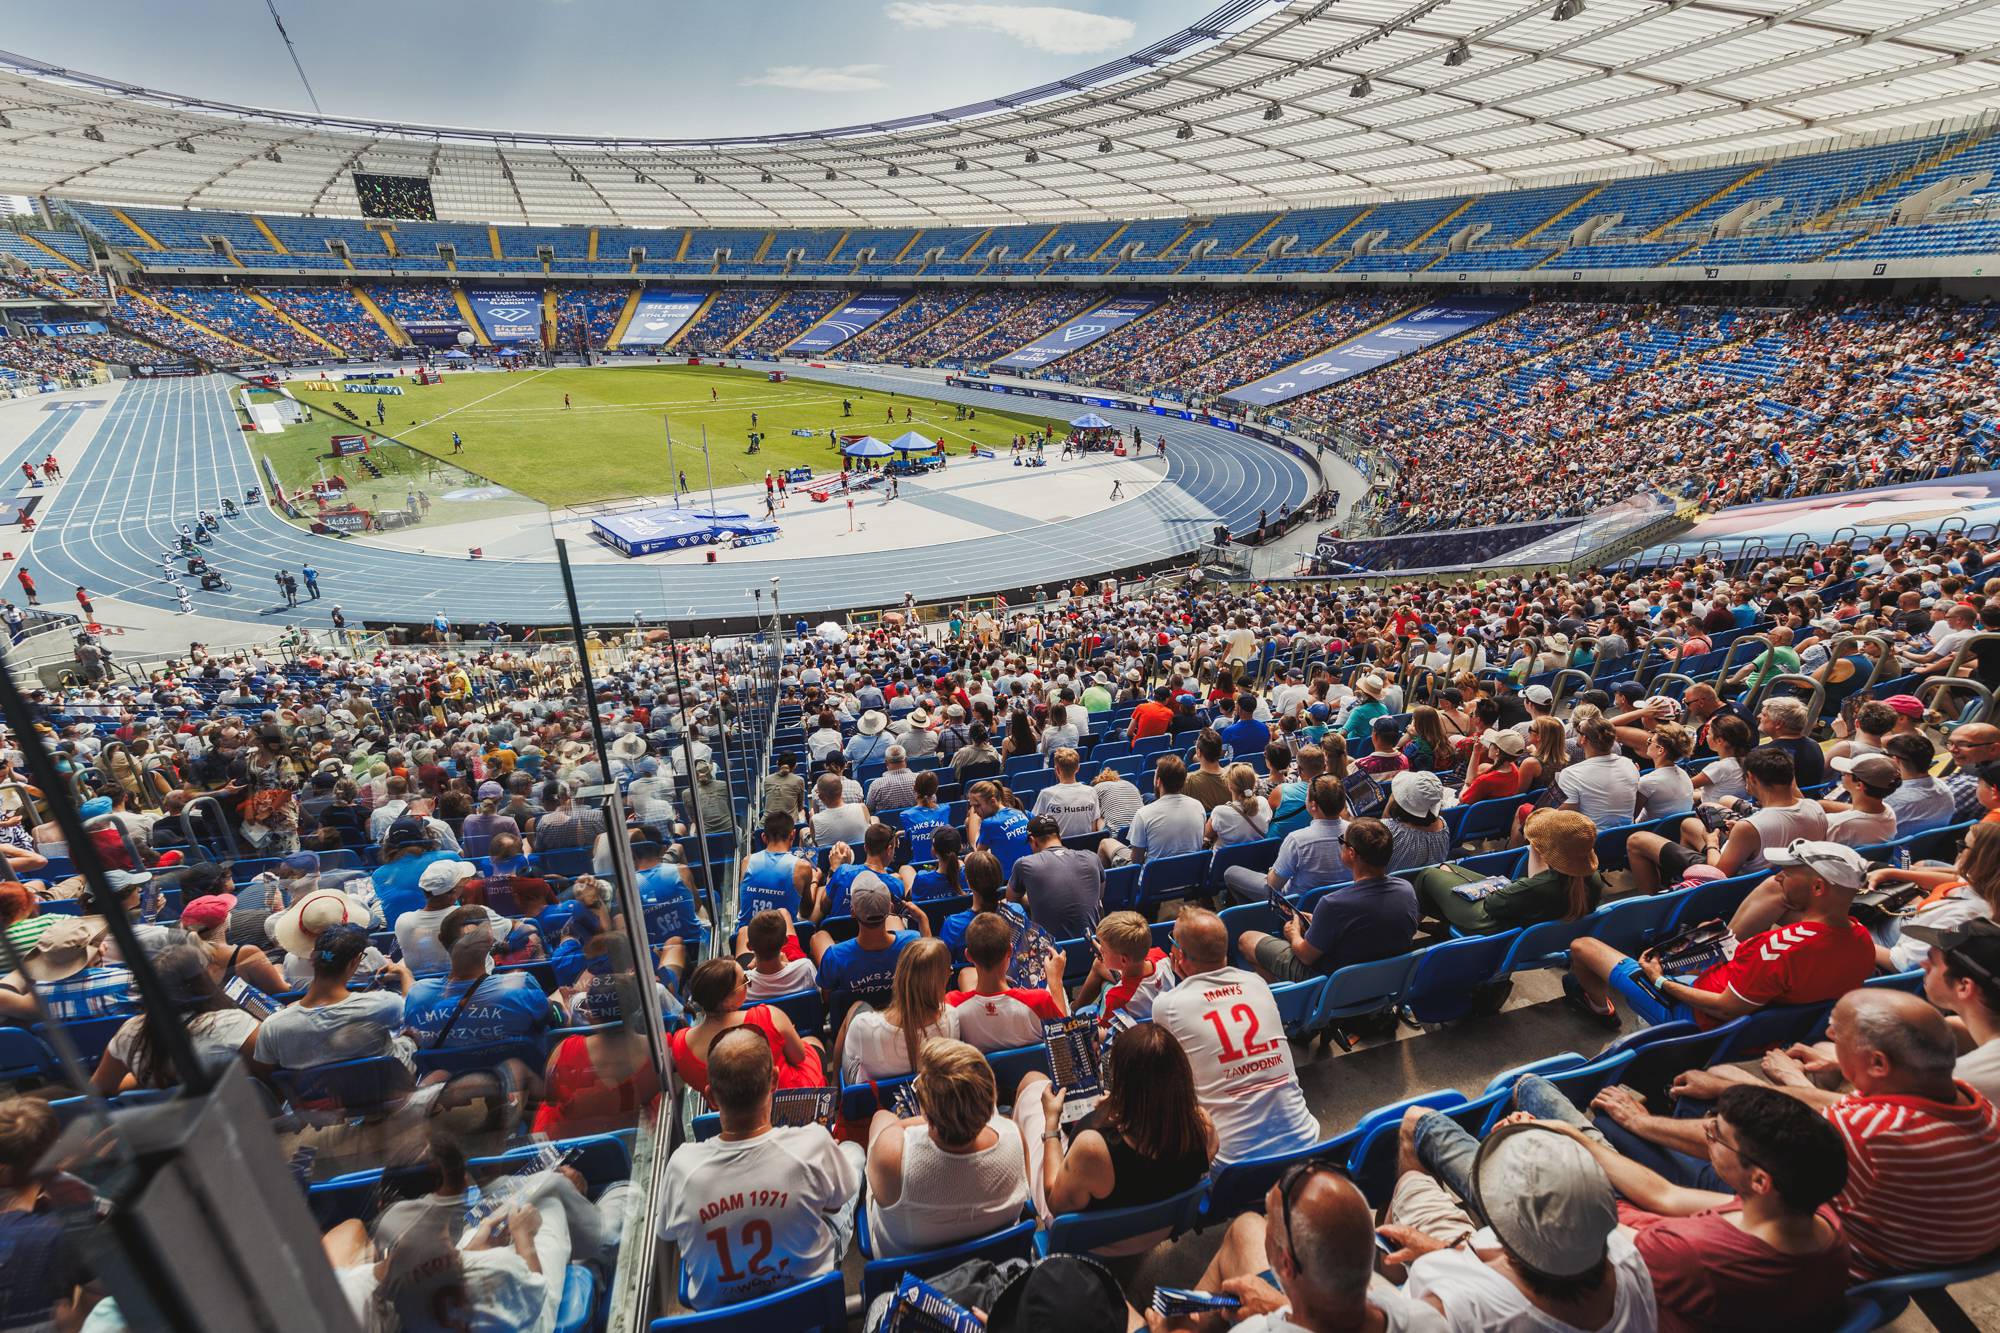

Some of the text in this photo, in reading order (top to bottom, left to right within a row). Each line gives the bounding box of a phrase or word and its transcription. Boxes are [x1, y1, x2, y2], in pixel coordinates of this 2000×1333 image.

[57, 325, 90, 334] SILESIA
[745, 536, 772, 545] SILESIA
[1050, 806, 1061, 814] KS
[912, 833, 930, 841] PYRZ
[467, 1003, 503, 1019] ŻAK
[1223, 1054, 1284, 1080] ZAWODNIK
[699, 1190, 788, 1224] ADAM 1971
